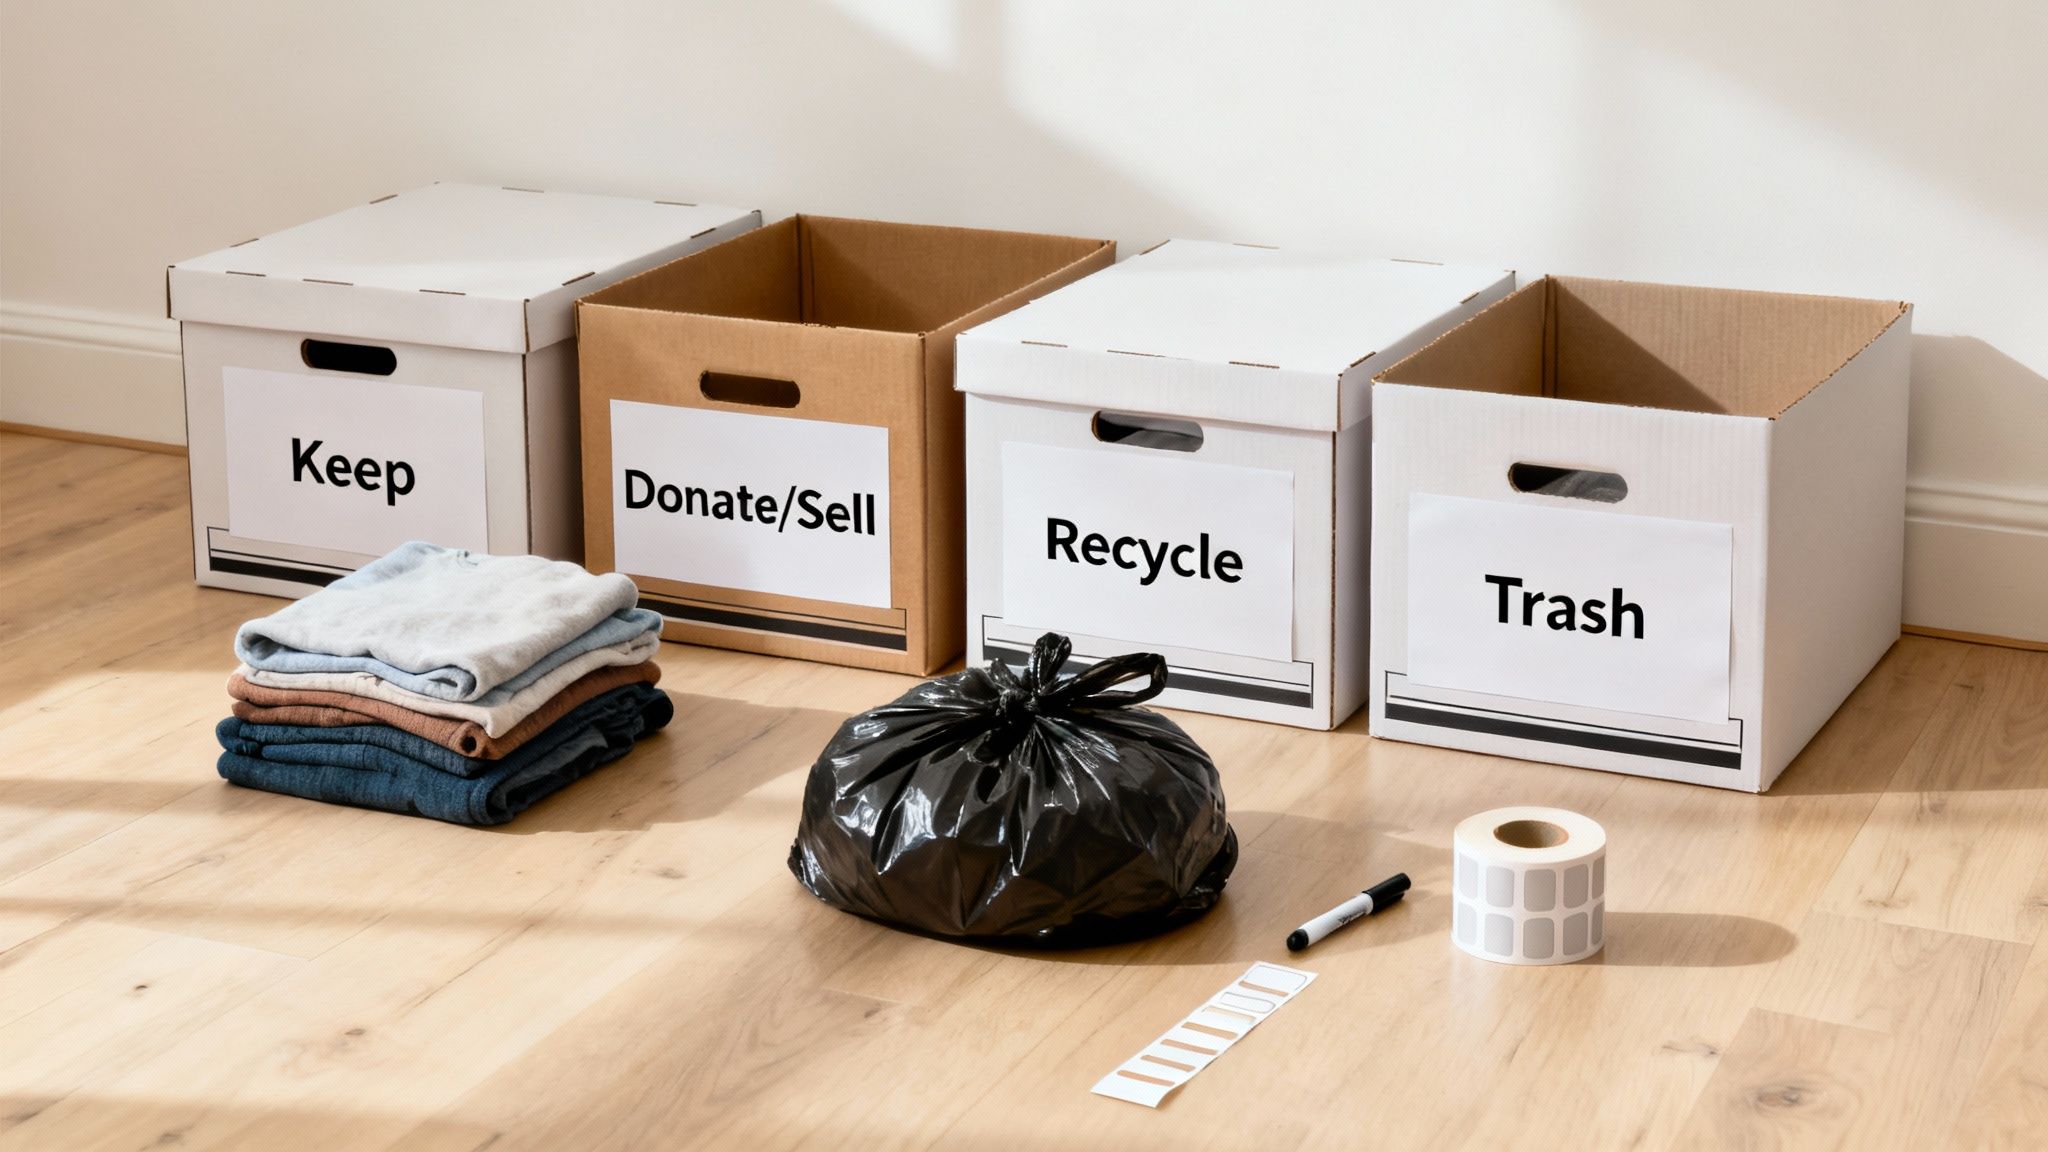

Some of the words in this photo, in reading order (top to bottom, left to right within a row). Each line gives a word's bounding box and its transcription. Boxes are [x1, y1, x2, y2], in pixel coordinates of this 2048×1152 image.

[291, 437, 416, 507] Keep
[624, 468, 876, 536] Donate/Sell
[1046, 517, 1244, 586] Recycle
[1485, 574, 1645, 640] Trash
